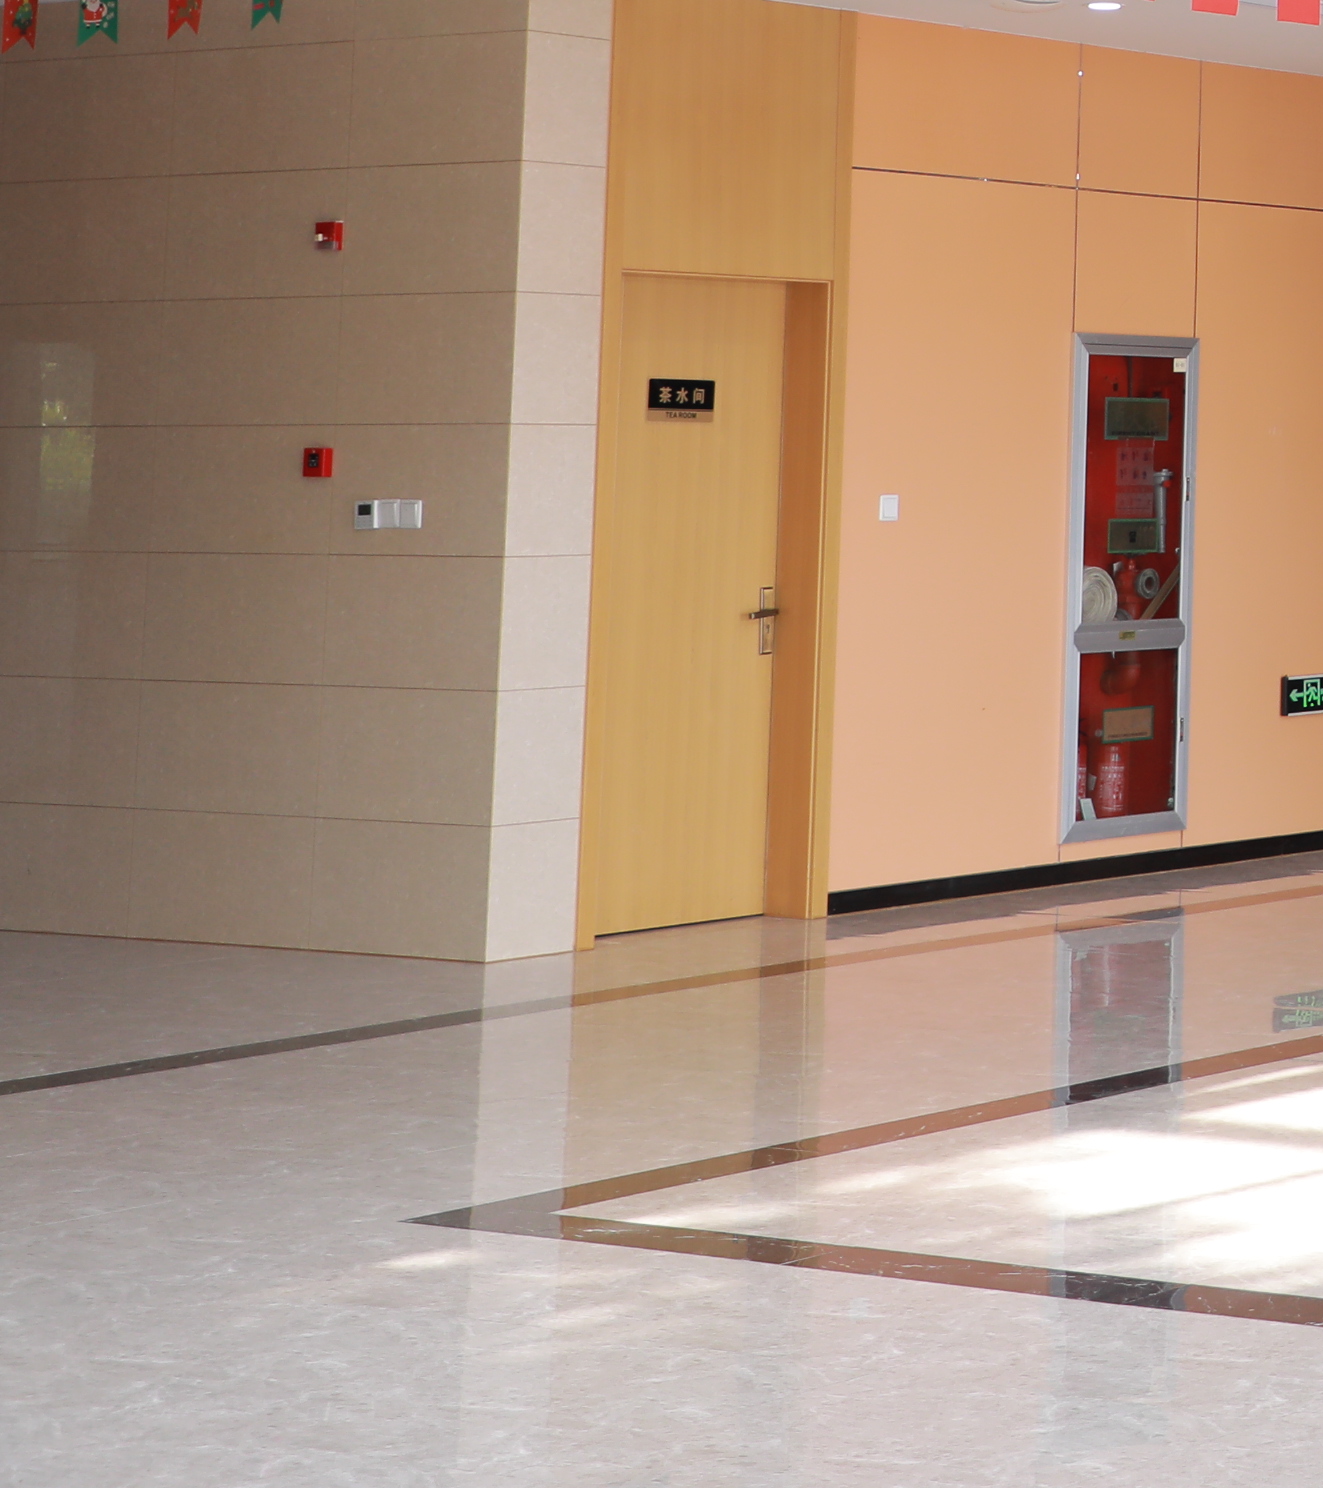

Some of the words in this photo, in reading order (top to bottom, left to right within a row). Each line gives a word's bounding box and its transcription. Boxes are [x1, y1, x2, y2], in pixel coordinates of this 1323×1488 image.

[658, 386, 706, 405] 茶水间
[666, 411, 678, 419] TEA
